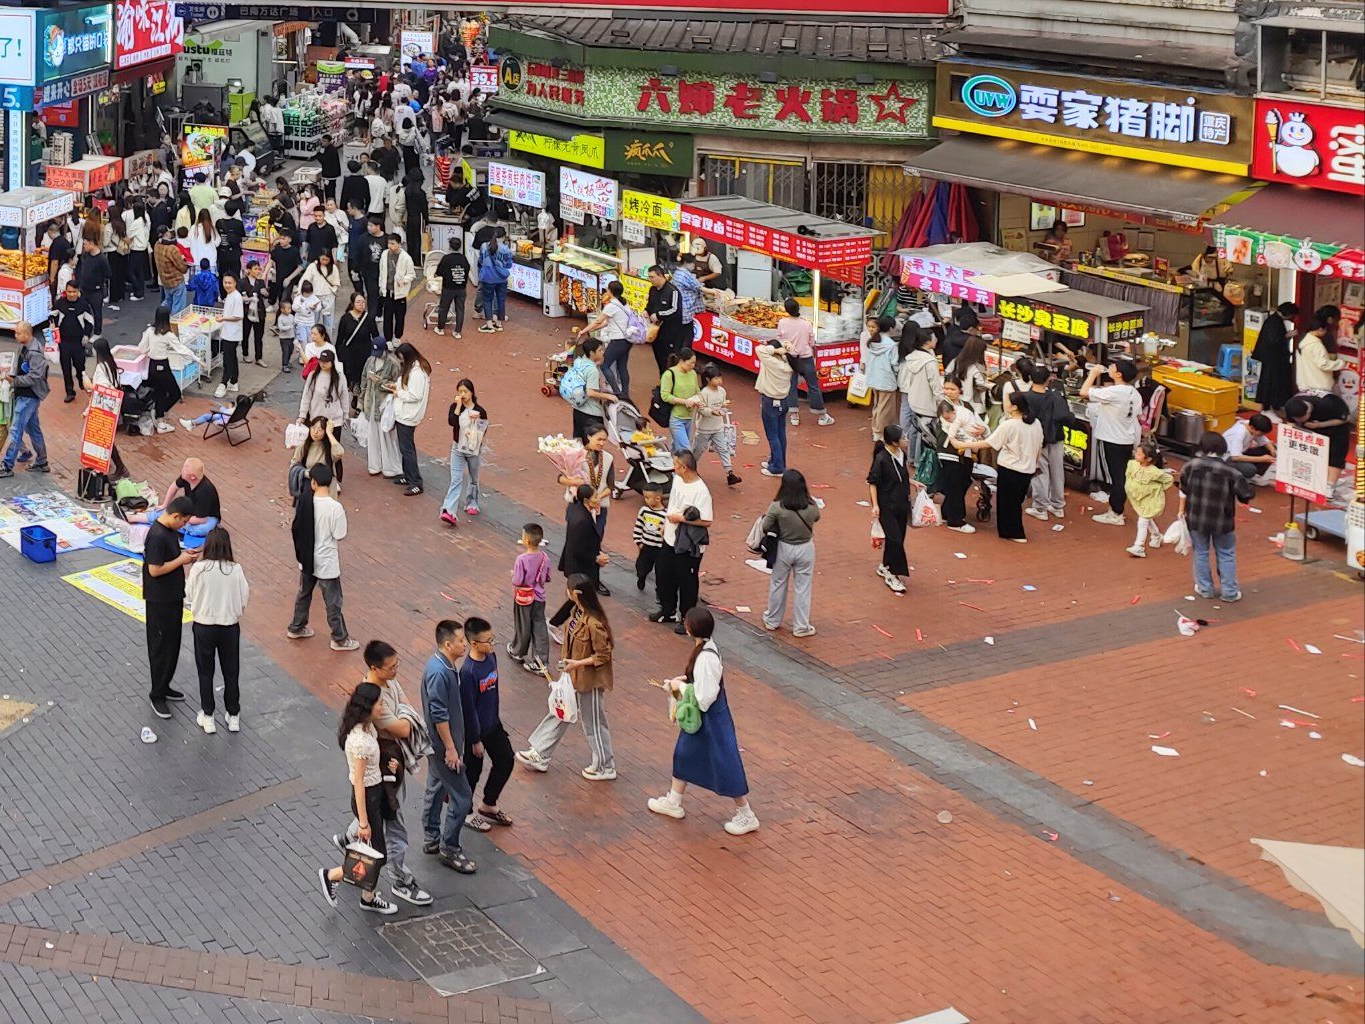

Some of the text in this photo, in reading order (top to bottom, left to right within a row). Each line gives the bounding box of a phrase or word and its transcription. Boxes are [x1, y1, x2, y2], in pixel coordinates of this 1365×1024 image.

[239, 6, 333, 17] 巴南万达广场 入口
[503, 66, 520, 86] A店
[973, 89, 1011, 110] UVW
[629, 197, 663, 218] 烤冷面
[919, 276, 990, 306] 全场2元
[998, 299, 1090, 340] 长沙臭豆腐
[1283, 428, 1325, 447] 扫码点单
